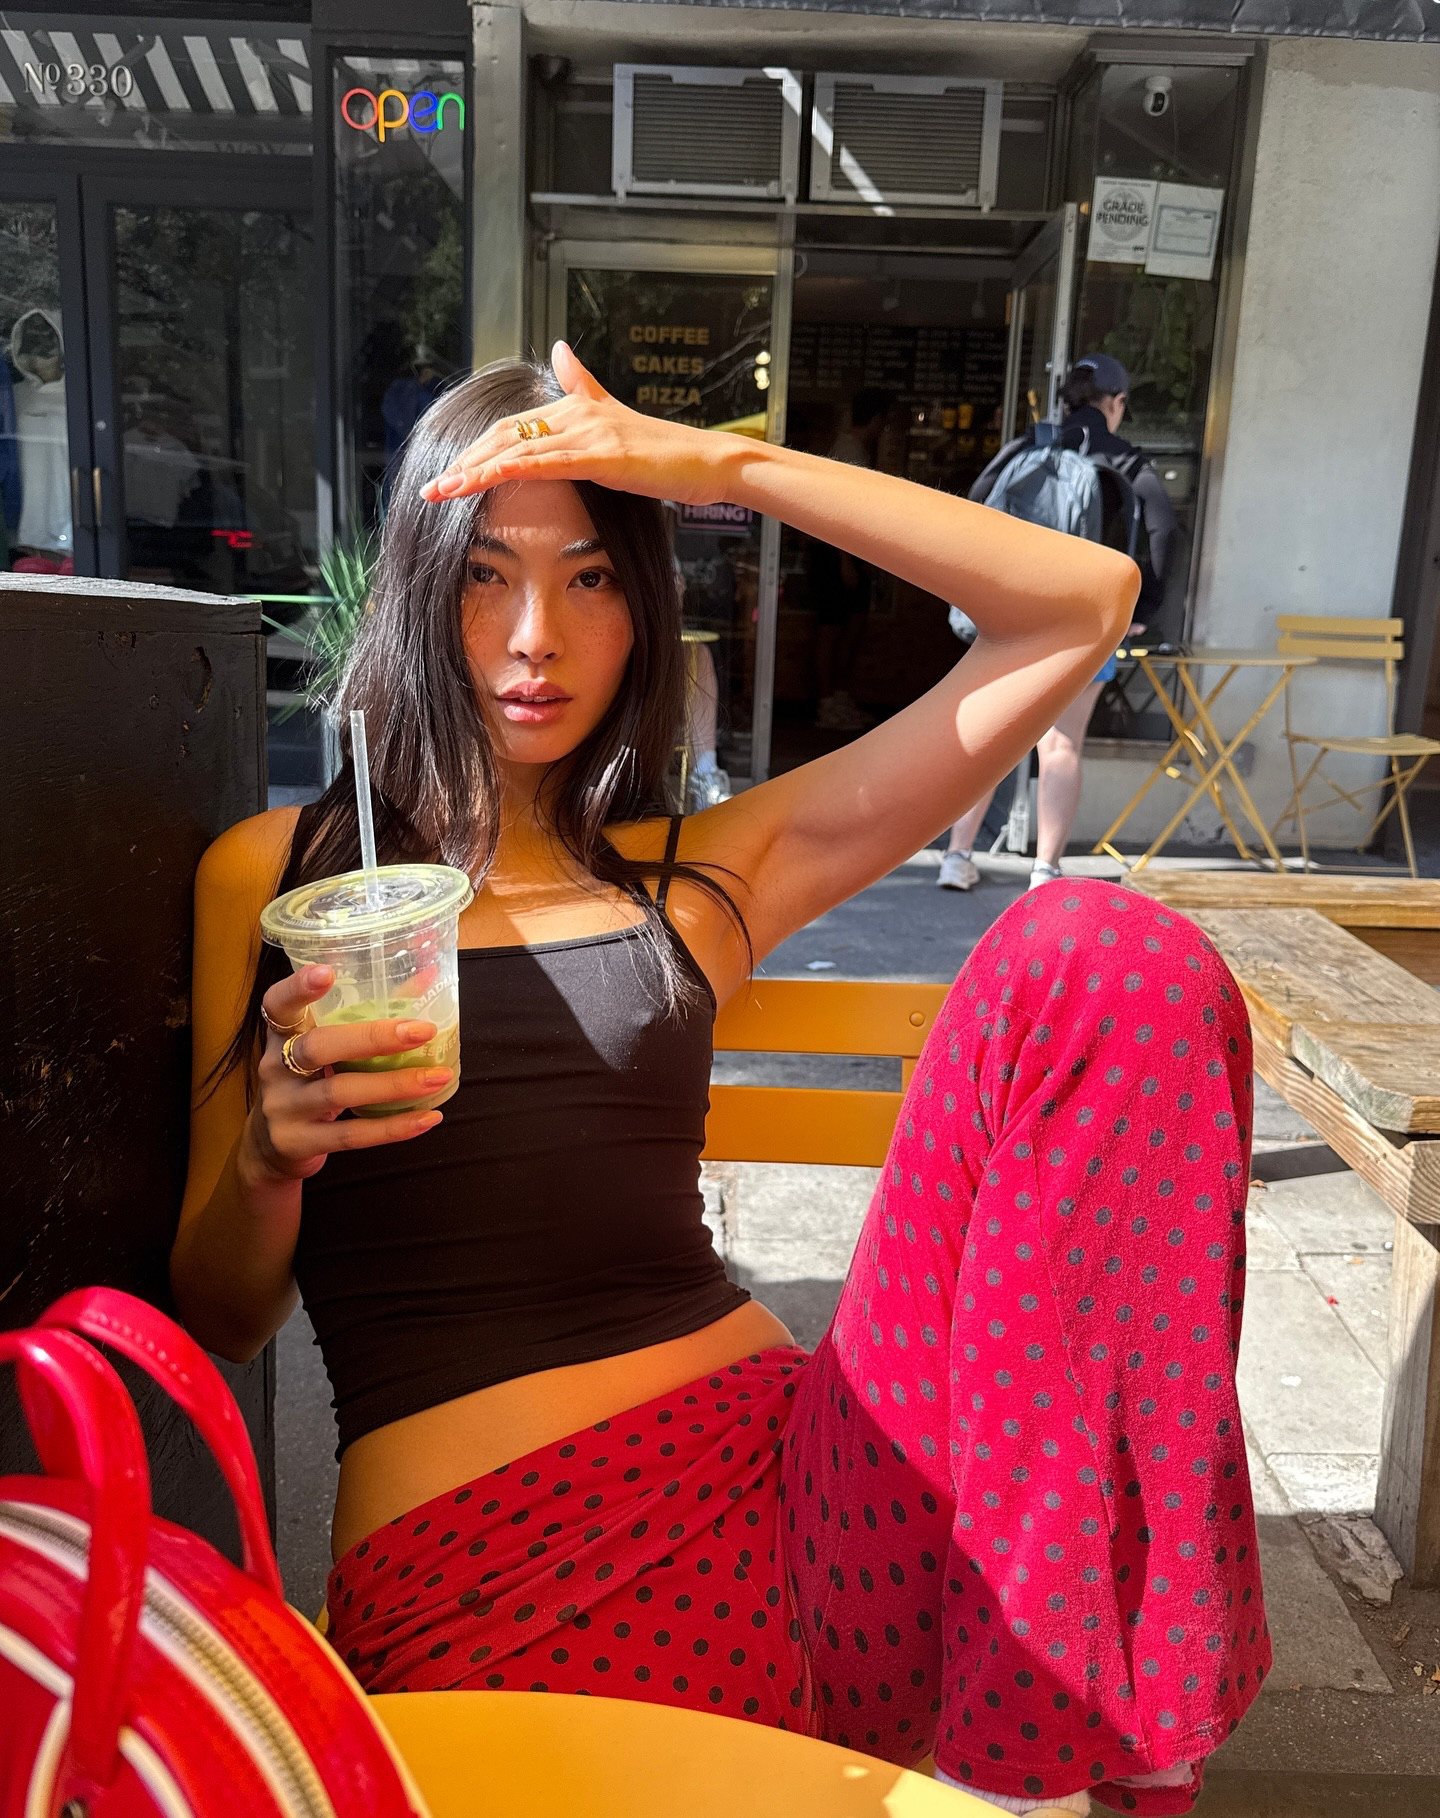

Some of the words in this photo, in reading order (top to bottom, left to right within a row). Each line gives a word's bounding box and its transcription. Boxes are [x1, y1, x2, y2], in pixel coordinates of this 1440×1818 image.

[341, 87, 465, 143] open
[1103, 199, 1145, 214] GRADE
[1095, 212, 1149, 227] PENDING
[629, 326, 710, 345] COFFEE
[632, 356, 704, 374] CAKES
[636, 386, 701, 404] PIZZA
